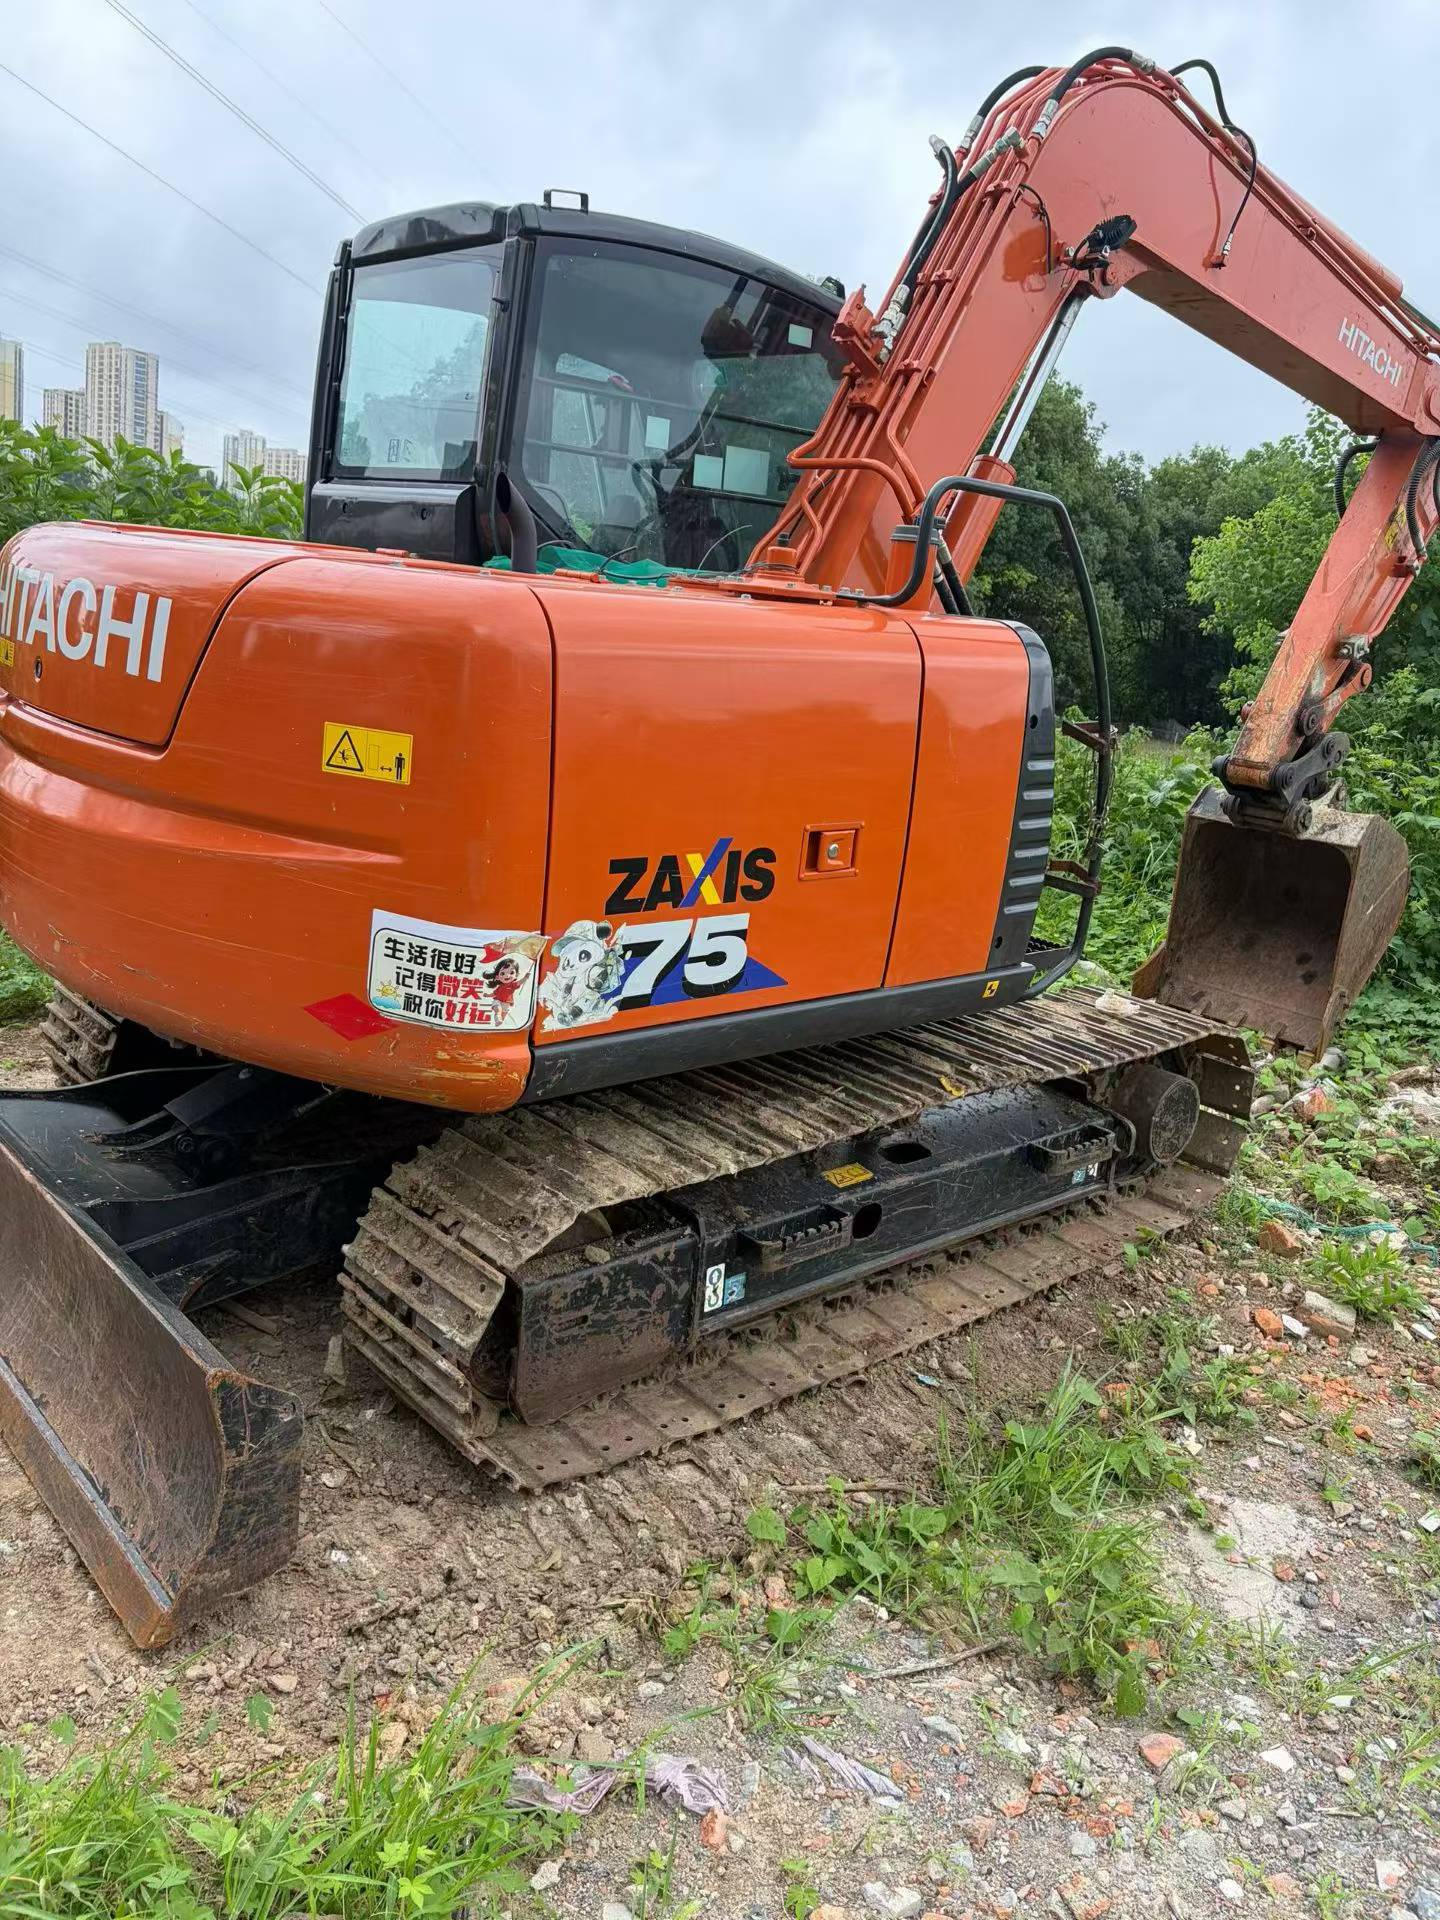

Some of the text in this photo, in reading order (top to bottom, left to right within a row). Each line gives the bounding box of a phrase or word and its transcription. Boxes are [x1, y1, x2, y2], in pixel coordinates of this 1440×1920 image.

[1338, 316, 1402, 387] HITACHI
[0, 563, 173, 683] HITACHI
[604, 837, 777, 915] ZAXIS
[384, 937, 477, 975] 生活很好
[395, 966, 485, 1000] 记得微笑
[618, 912, 751, 1003] 75
[402, 992, 494, 1025] 祝你好运
